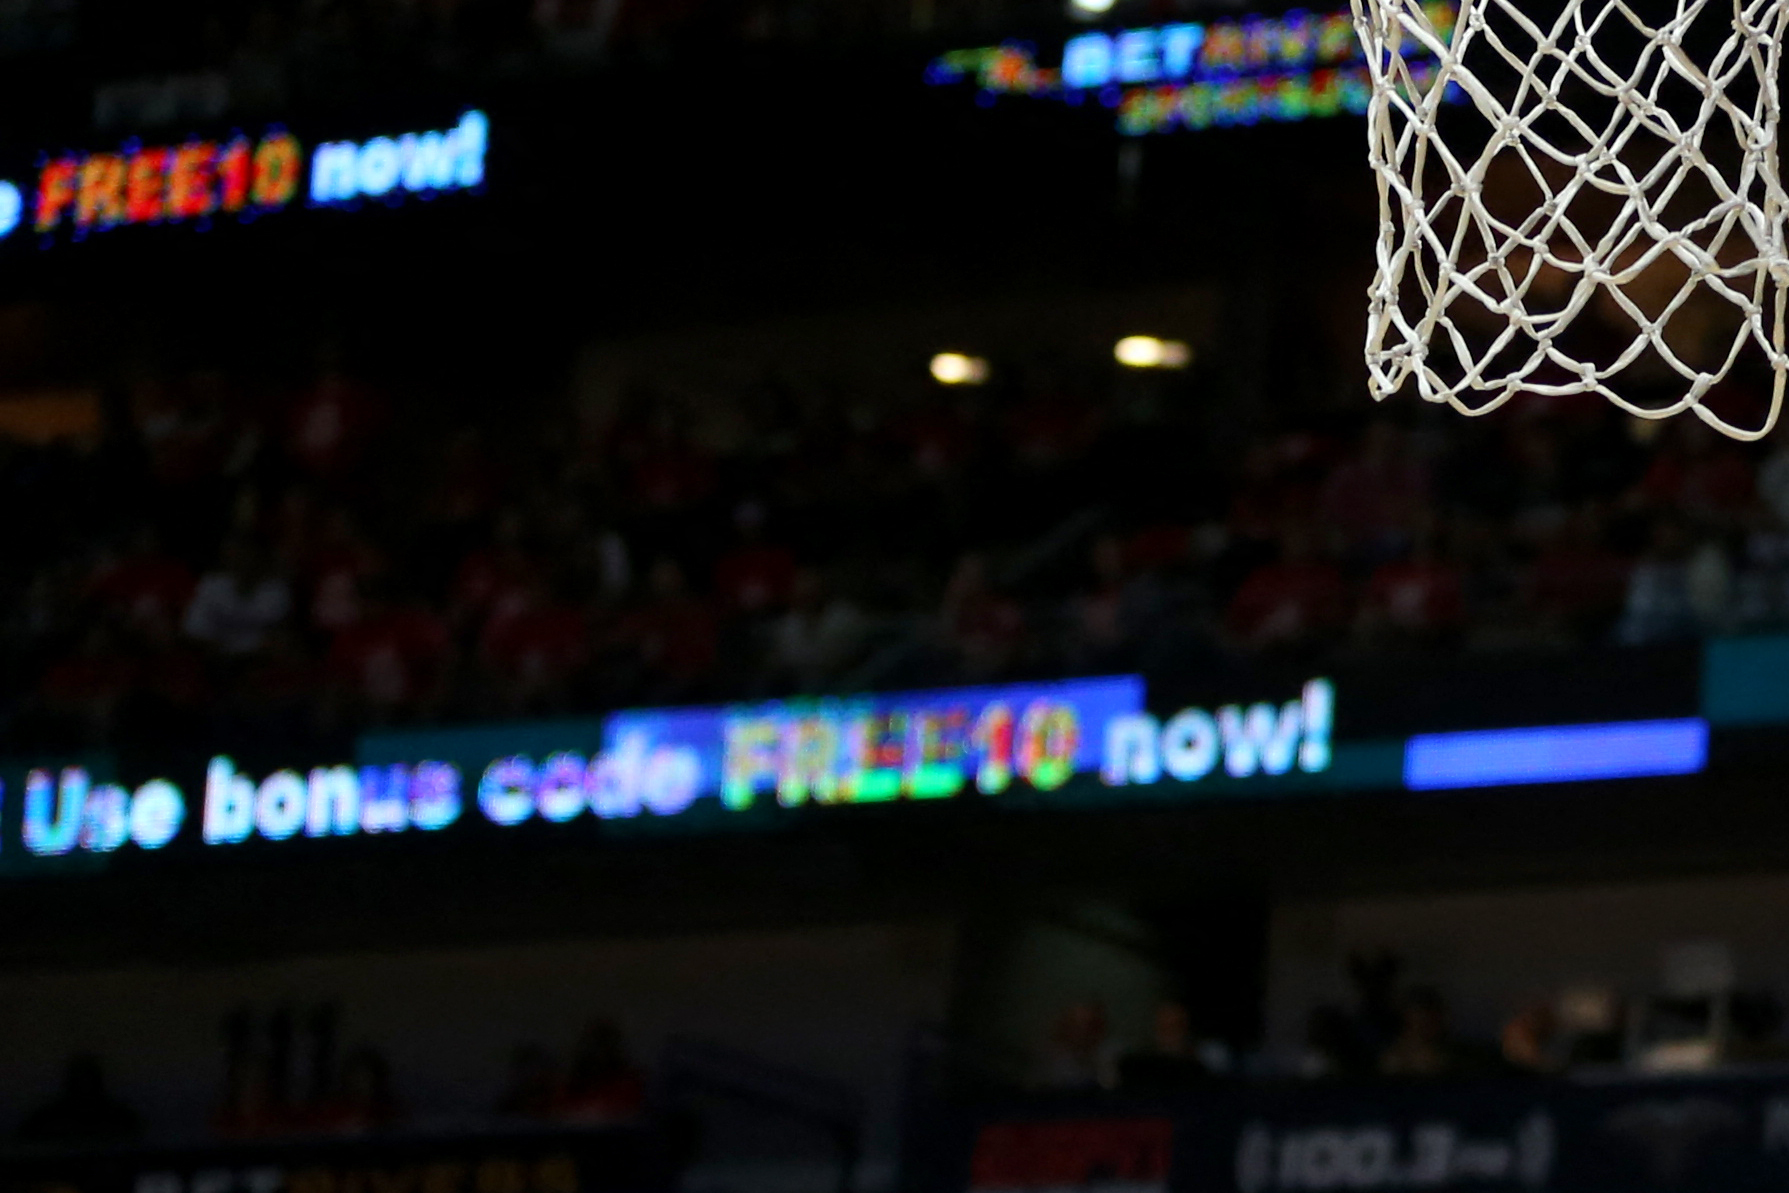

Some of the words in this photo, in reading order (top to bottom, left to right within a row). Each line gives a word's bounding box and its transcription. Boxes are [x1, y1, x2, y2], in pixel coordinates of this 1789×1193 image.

[34, 134, 302, 233] FREE10
[309, 108, 490, 202] now!
[22, 768, 185, 855] Use
[203, 754, 463, 845] bonus
[478, 727, 702, 826] code
[1103, 677, 1336, 787] now!
